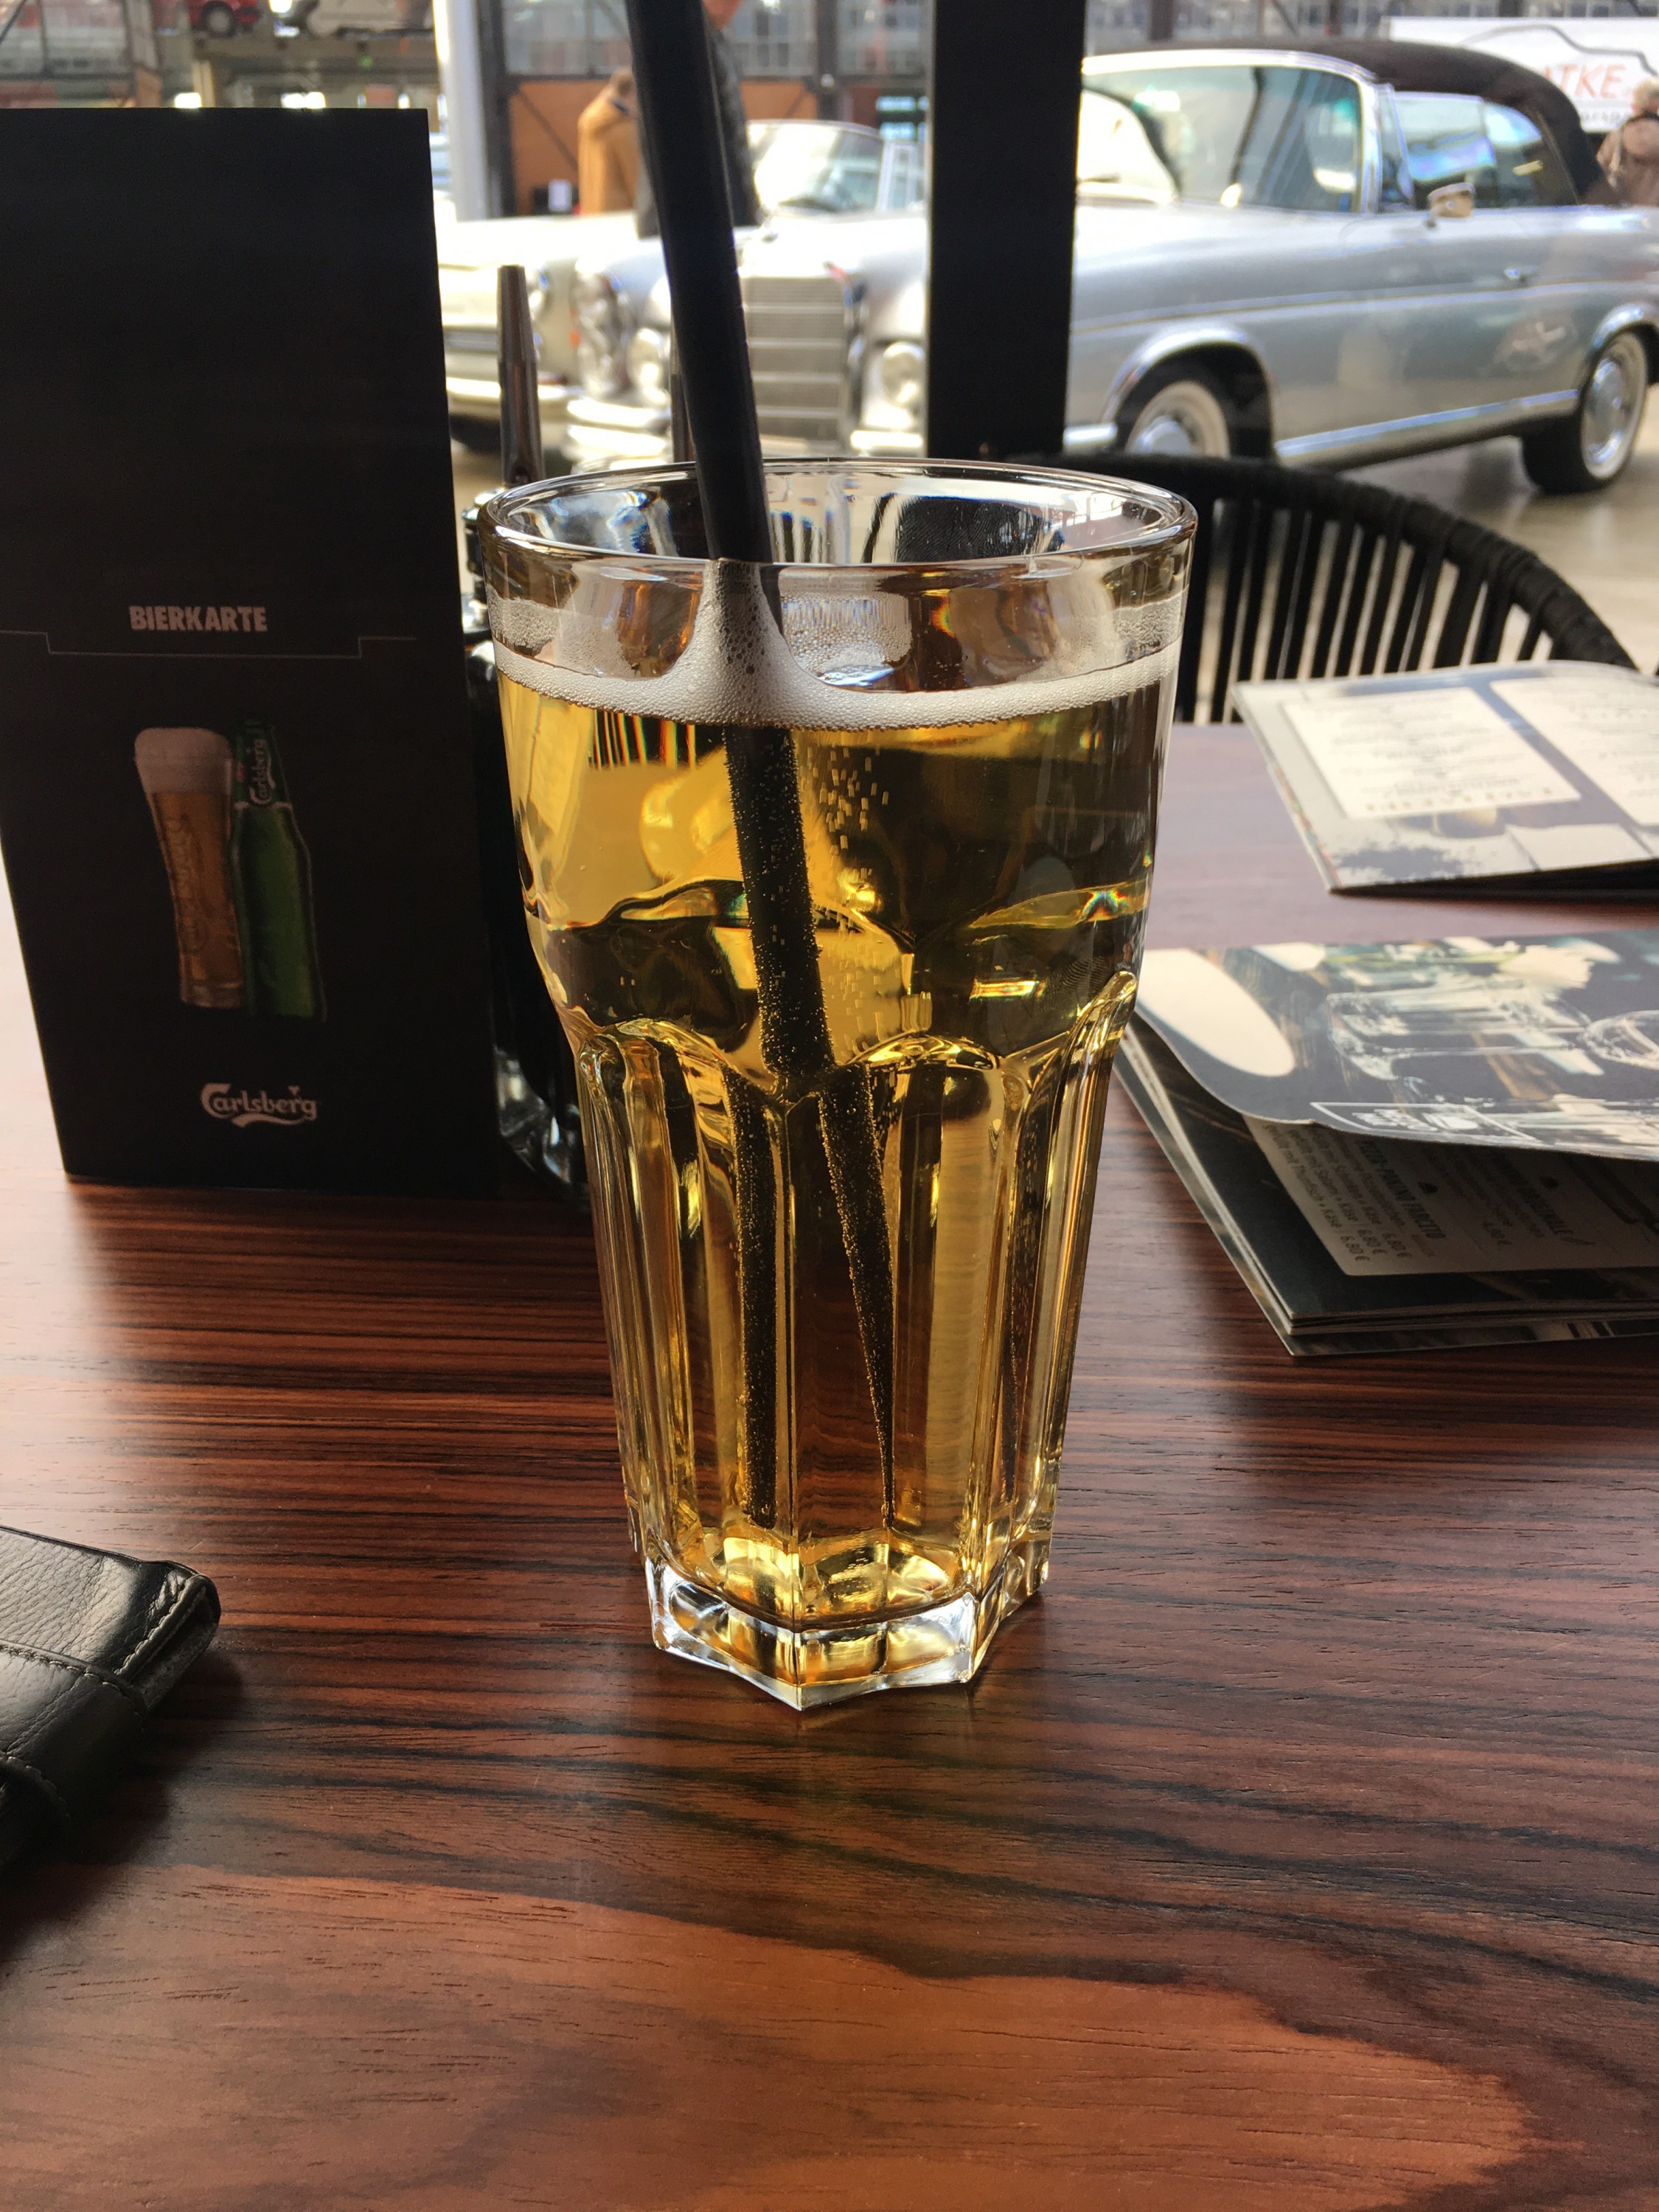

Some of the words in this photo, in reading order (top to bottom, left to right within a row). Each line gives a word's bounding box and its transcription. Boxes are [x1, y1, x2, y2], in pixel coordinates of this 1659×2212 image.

[129, 605, 268, 632] BIERKARTE
[246, 739, 276, 804] Carlsberg
[200, 1082, 318, 1128] Carlsberg
